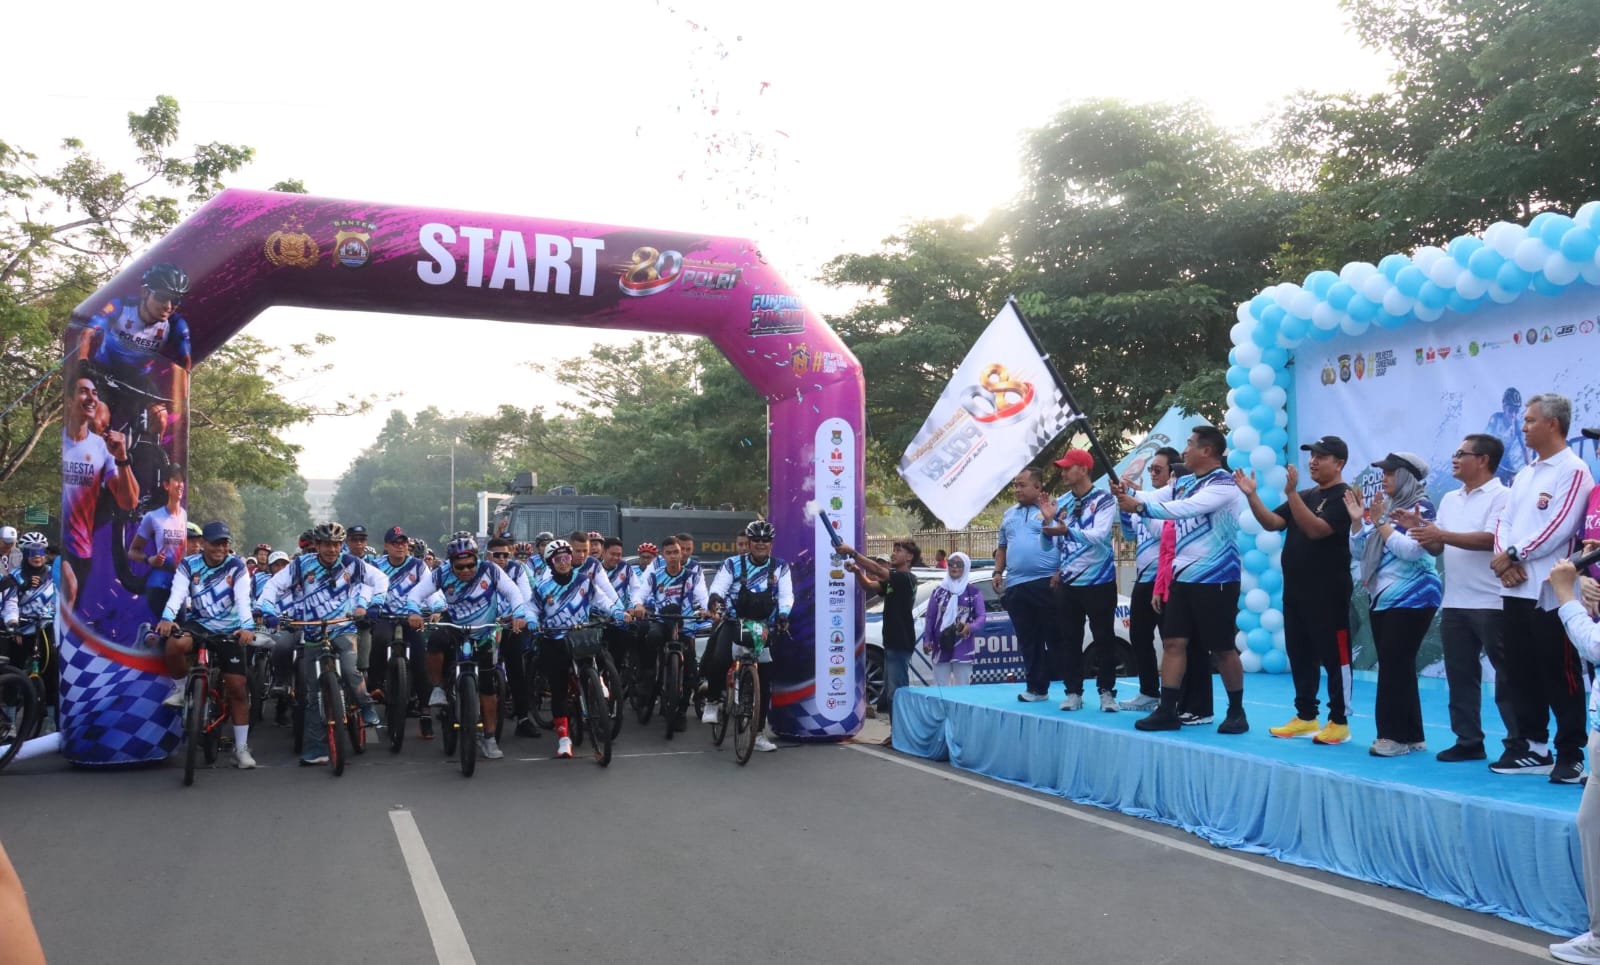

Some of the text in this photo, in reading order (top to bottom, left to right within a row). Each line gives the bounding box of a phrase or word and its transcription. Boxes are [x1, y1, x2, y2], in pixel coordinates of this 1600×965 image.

[333, 219, 377, 230] BANTEN
[416, 222, 604, 297] START
[622, 246, 683, 290] 80
[681, 270, 737, 290] POLRI
[974, 635, 1018, 654] POLI
[974, 656, 1000, 665] LALU
